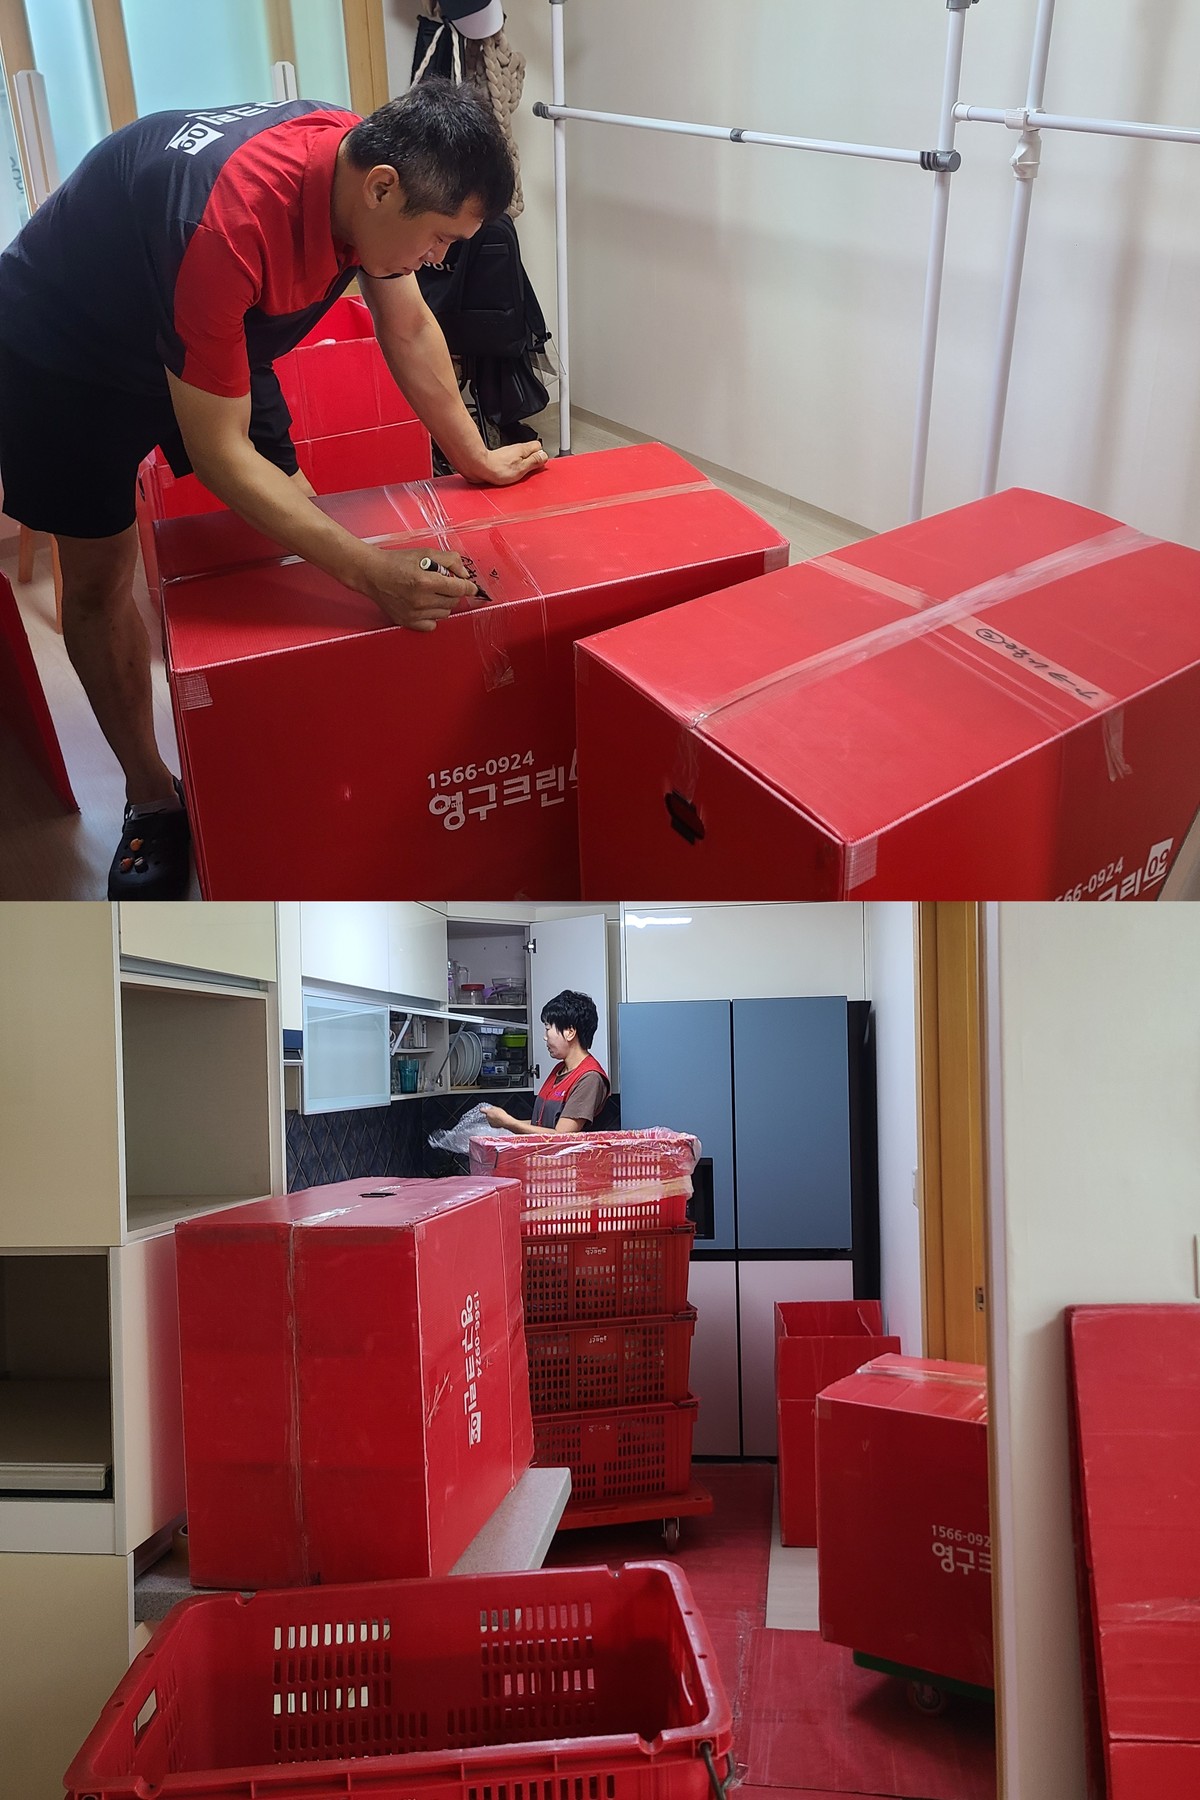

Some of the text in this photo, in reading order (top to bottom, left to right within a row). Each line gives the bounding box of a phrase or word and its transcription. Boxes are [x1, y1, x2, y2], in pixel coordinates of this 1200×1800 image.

[427, 750, 535, 789] 1566-0924
[428, 765, 566, 831] 영구크린
[460, 1294, 477, 1416] 영구크린
[473, 1291, 482, 1378] 1566-0924
